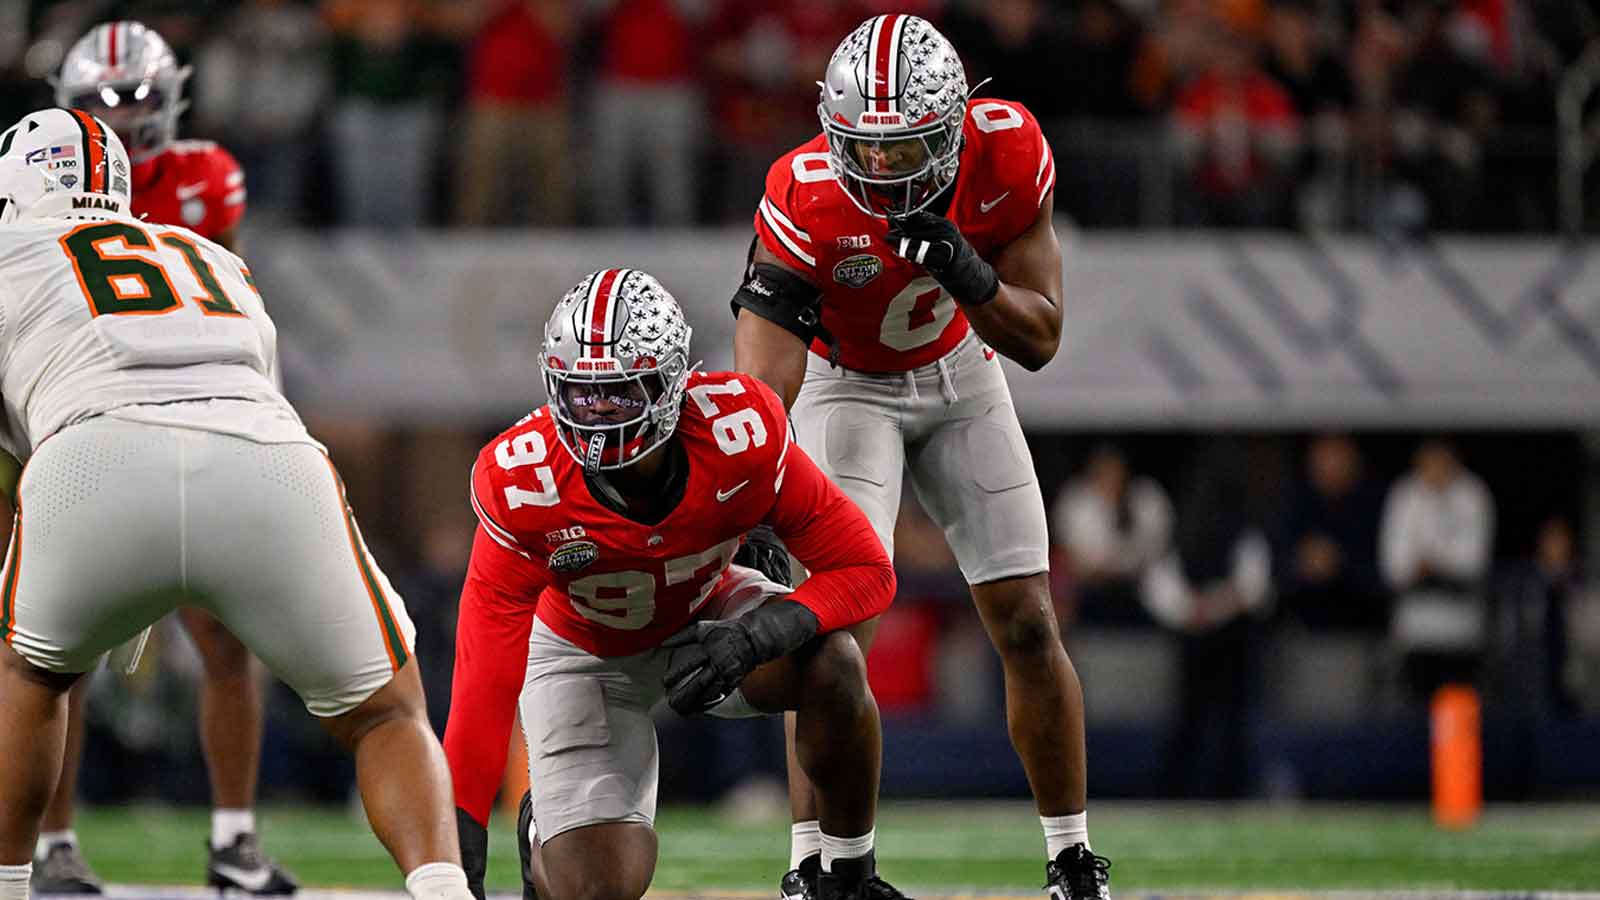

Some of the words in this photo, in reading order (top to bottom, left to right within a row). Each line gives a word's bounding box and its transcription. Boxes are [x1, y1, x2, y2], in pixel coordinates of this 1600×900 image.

[862, 115, 878, 124] OHIO
[880, 115, 901, 124] STATE
[971, 102, 1024, 133] 0
[62, 160, 76, 168] 100
[791, 152, 839, 184] 0
[72, 197, 119, 213] MIAMI
[57, 220, 249, 318] 61
[880, 276, 956, 351] 0
[577, 361, 592, 370] OHIO
[595, 361, 615, 371] STATE
[687, 379, 768, 456] 97
[494, 430, 561, 510] 97
[567, 537, 741, 631] 97
